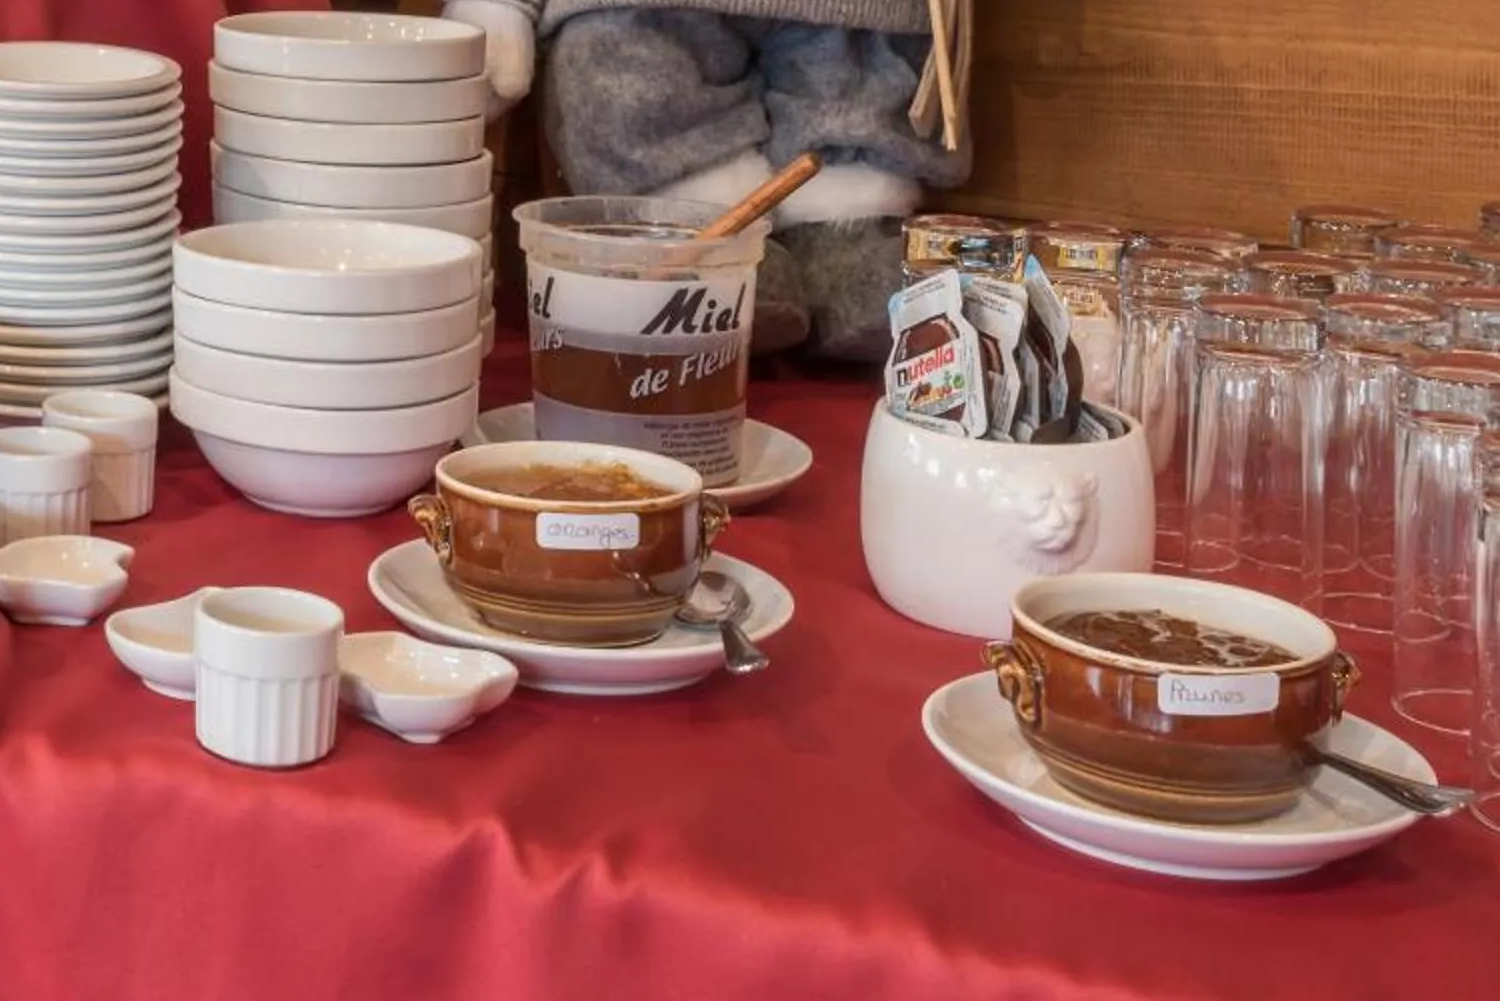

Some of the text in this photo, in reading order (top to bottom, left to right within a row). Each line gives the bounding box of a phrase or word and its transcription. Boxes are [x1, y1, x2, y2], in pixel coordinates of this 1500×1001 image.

[640, 282, 747, 335] Miel
[629, 367, 670, 399] de
[896, 347, 956, 388] nutella
